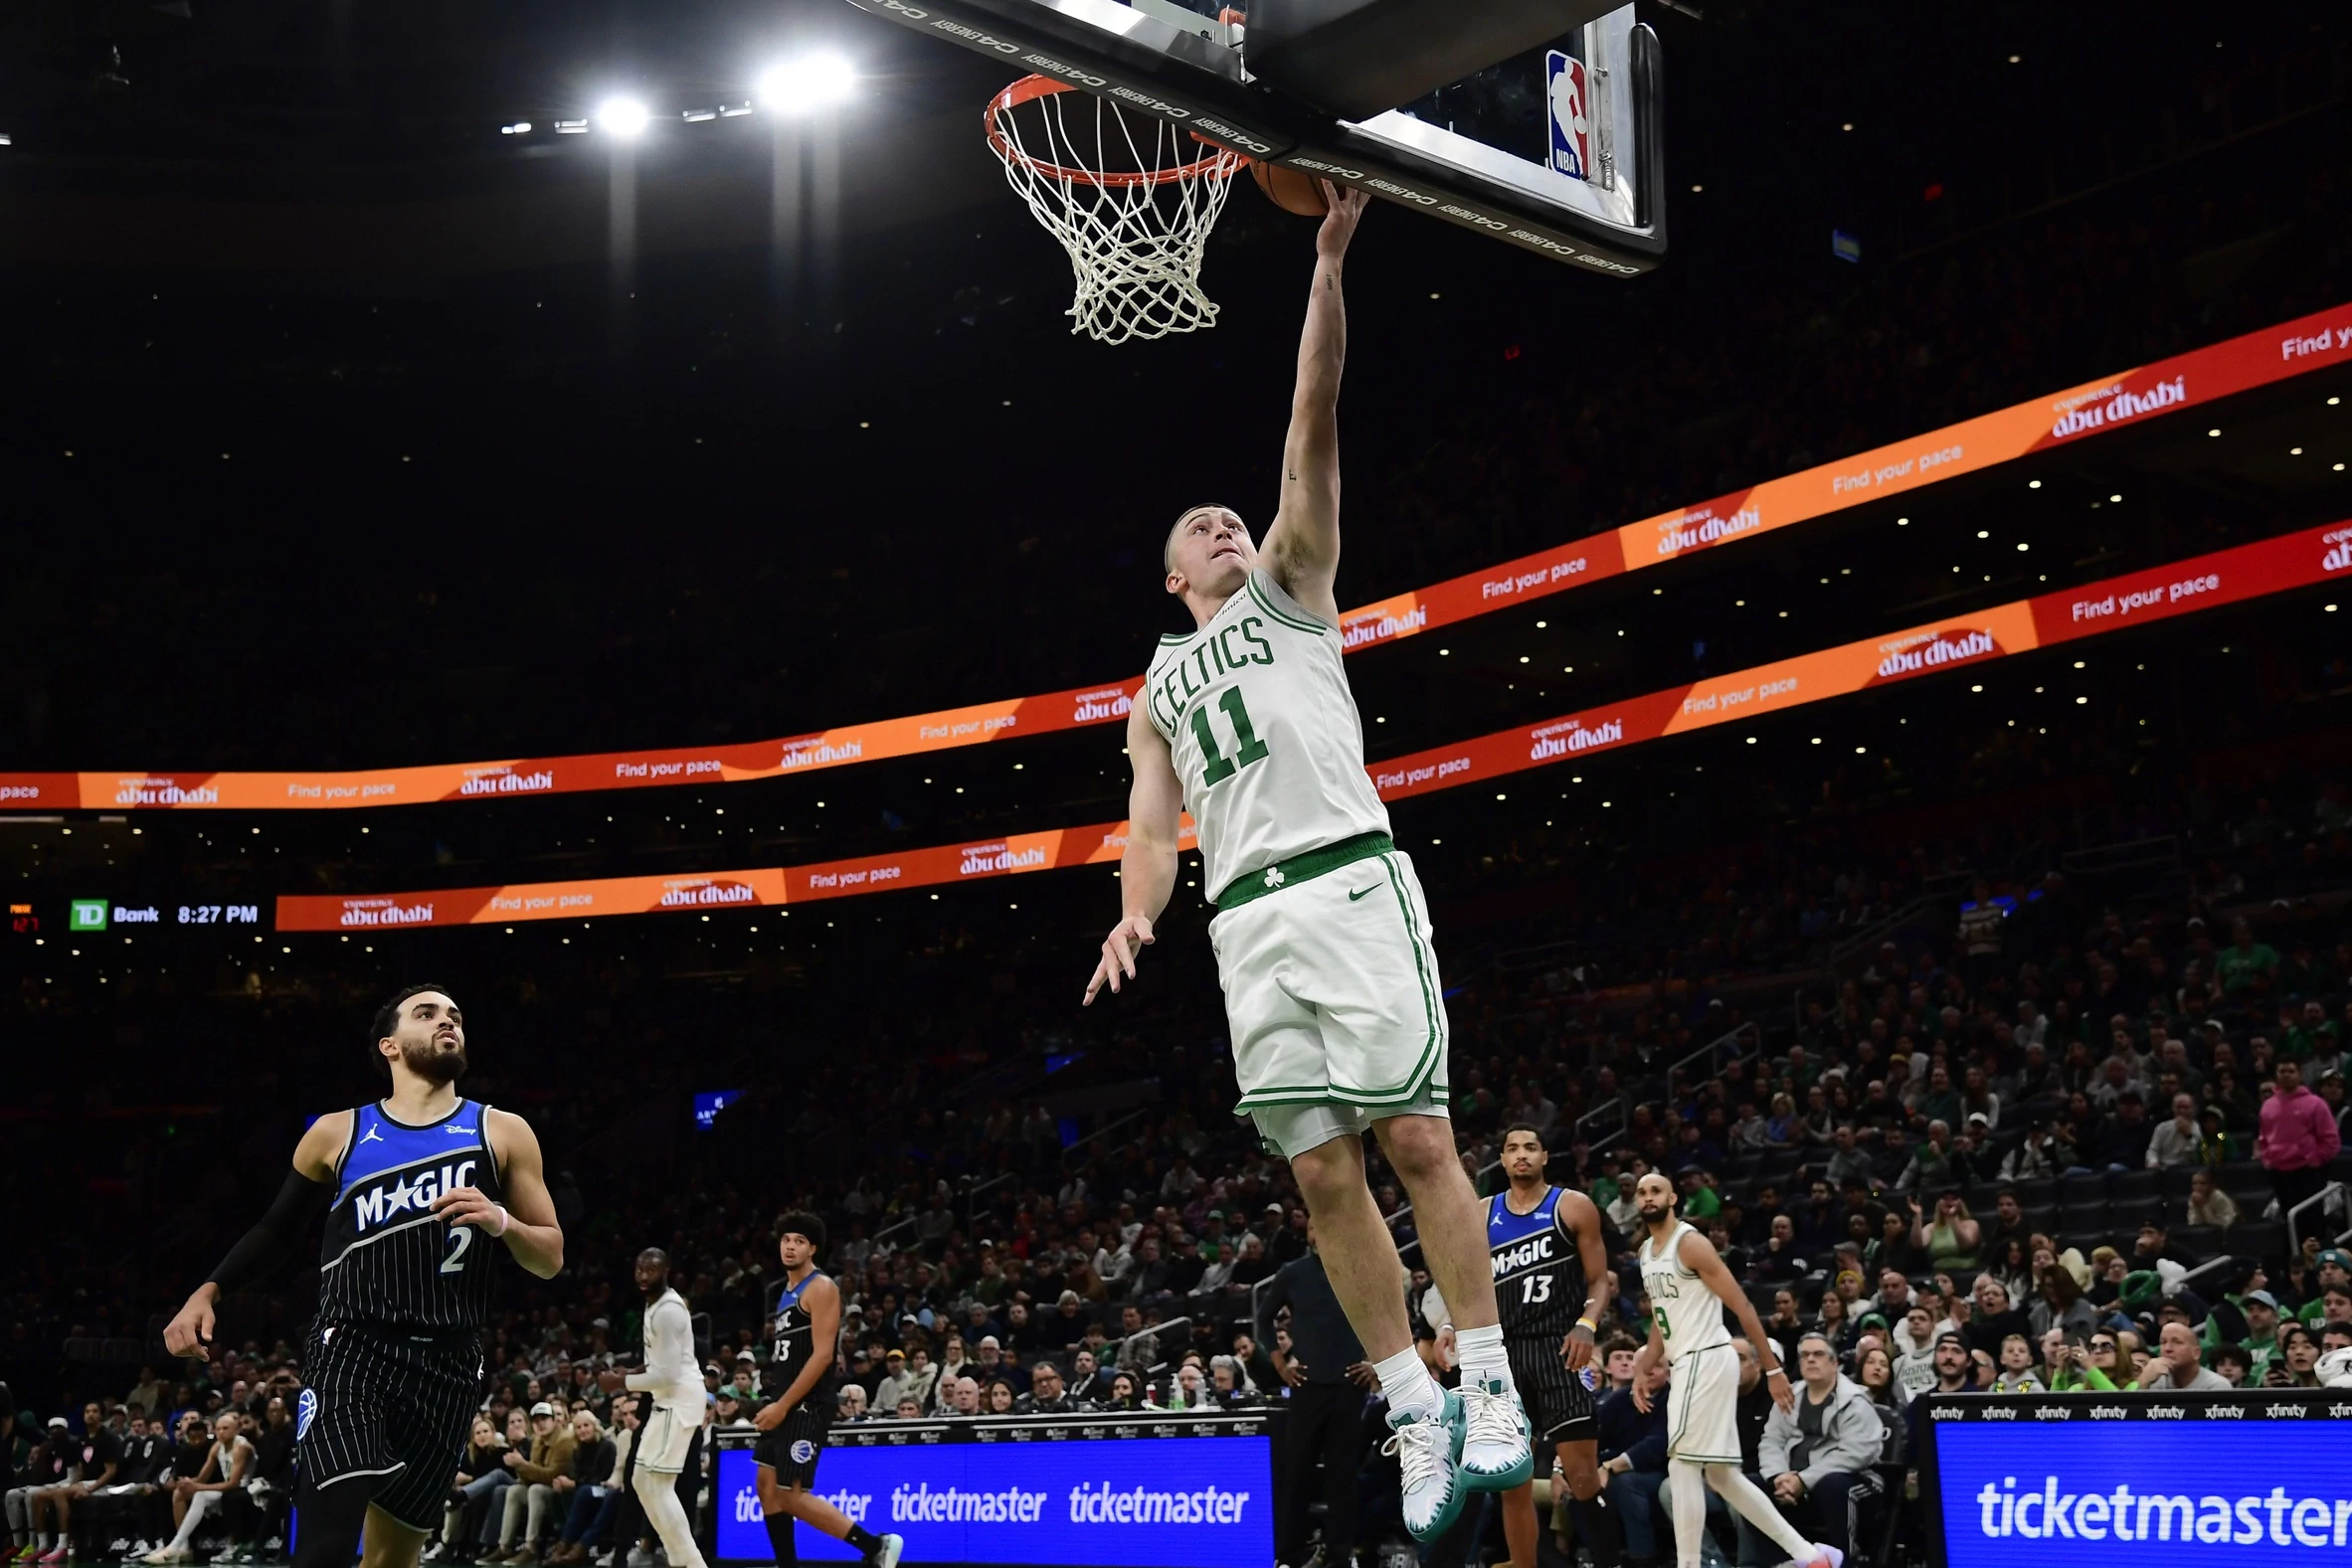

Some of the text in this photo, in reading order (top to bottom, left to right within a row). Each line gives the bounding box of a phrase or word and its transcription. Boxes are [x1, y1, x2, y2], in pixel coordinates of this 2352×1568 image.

[1555, 148, 1576, 174] NBA
[2280, 327, 2332, 360] Find
[2053, 375, 2186, 438] abu dhabi
[1832, 444, 1963, 494] Find your pace
[1657, 504, 1761, 555] abu dhabi
[1482, 557, 1586, 599] Find your pace
[2072, 574, 2220, 621] Find your pace
[1377, 605, 1426, 639] dhabi
[1878, 628, 1994, 677] abu dhabi
[1152, 615, 1275, 738] CELTICS
[1683, 677, 1798, 715] Find your pace
[1074, 701, 1110, 722] abu
[920, 715, 1017, 740] Find your pace
[1189, 684, 1270, 788] 11
[1530, 718, 1623, 761] abu dhabi
[781, 739, 862, 769] abu dhabi
[616, 760, 722, 779] Find your pace
[1376, 757, 1471, 790] Find your pace
[0, 785, 40, 801] pace
[115, 784, 219, 804] abu dhabi
[287, 783, 396, 800] Find your pace
[460, 771, 553, 795] abu dhabi
[960, 846, 1045, 876] abu dhabi
[810, 866, 901, 889] Find your pace
[490, 893, 594, 911] Find your pace
[660, 883, 753, 907] abu dhabi
[76, 904, 159, 926] TD Bank
[178, 905, 258, 924] 8:27 PM
[340, 903, 434, 926] abu dhabi
[444, 1125, 476, 1135] Disney
[440, 1226, 472, 1273] 2
[1522, 1275, 1553, 1304] 13
[1930, 1406, 1965, 1420] xfinity
[1981, 1406, 2018, 1421] xfinity
[2035, 1405, 2072, 1421] xfinity
[2089, 1405, 2128, 1420] xfinity
[2146, 1404, 2185, 1420] xfinity
[2205, 1404, 2246, 1420] xfinity
[2265, 1403, 2307, 1419] xfinity
[736, 1485, 872, 1522] ticster
[891, 1482, 1047, 1522] ticketmaster
[1070, 1481, 1249, 1524] ticketmaster
[1977, 1476, 2352, 1547] ticketmaster
